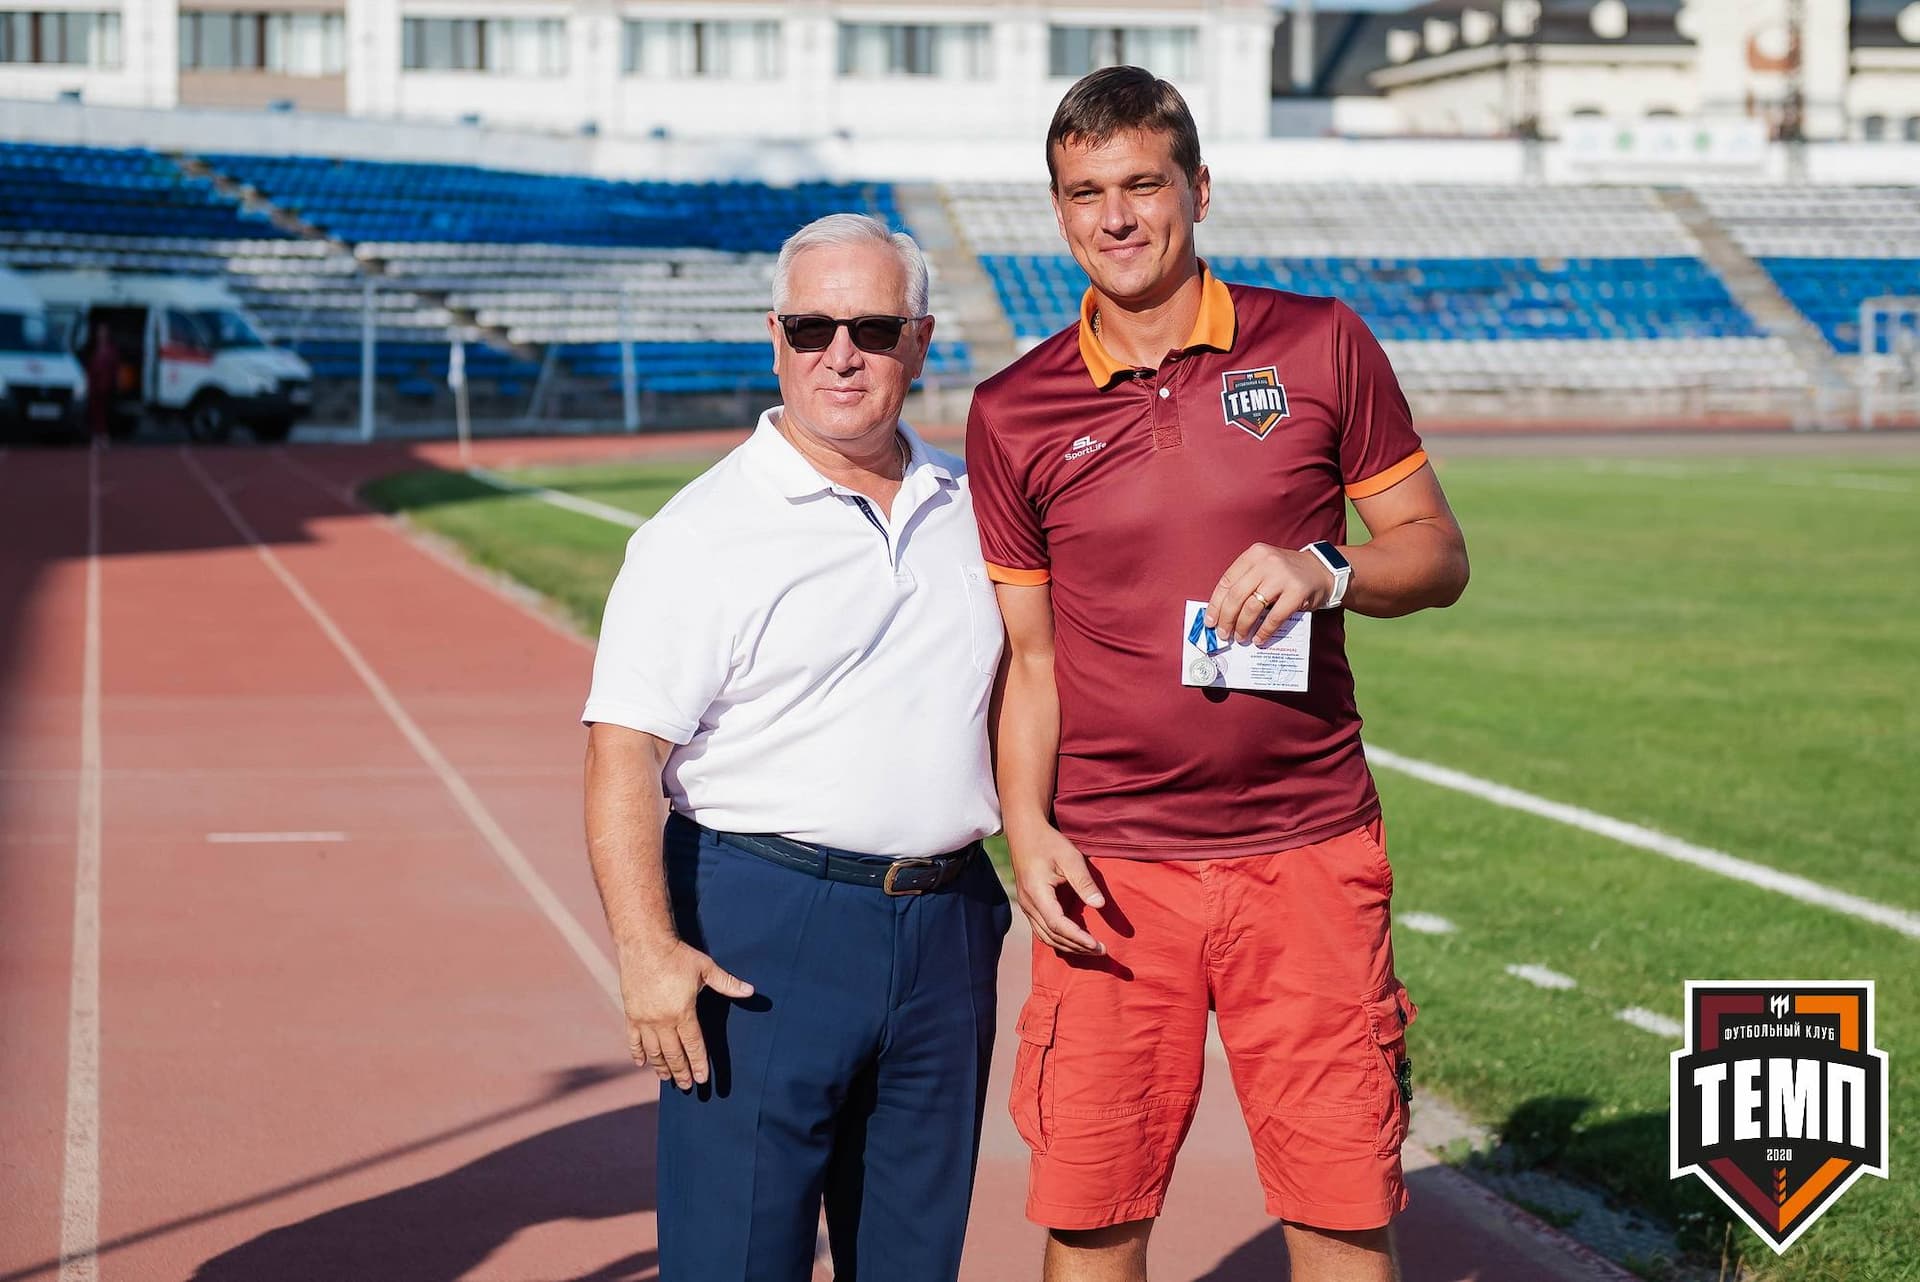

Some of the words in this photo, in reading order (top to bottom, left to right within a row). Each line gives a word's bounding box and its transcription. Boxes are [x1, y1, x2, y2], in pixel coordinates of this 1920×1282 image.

[1228, 388, 1282, 416] ТЕМП
[1064, 442, 1107, 461] SportLife
[1072, 435, 1098, 450] SL
